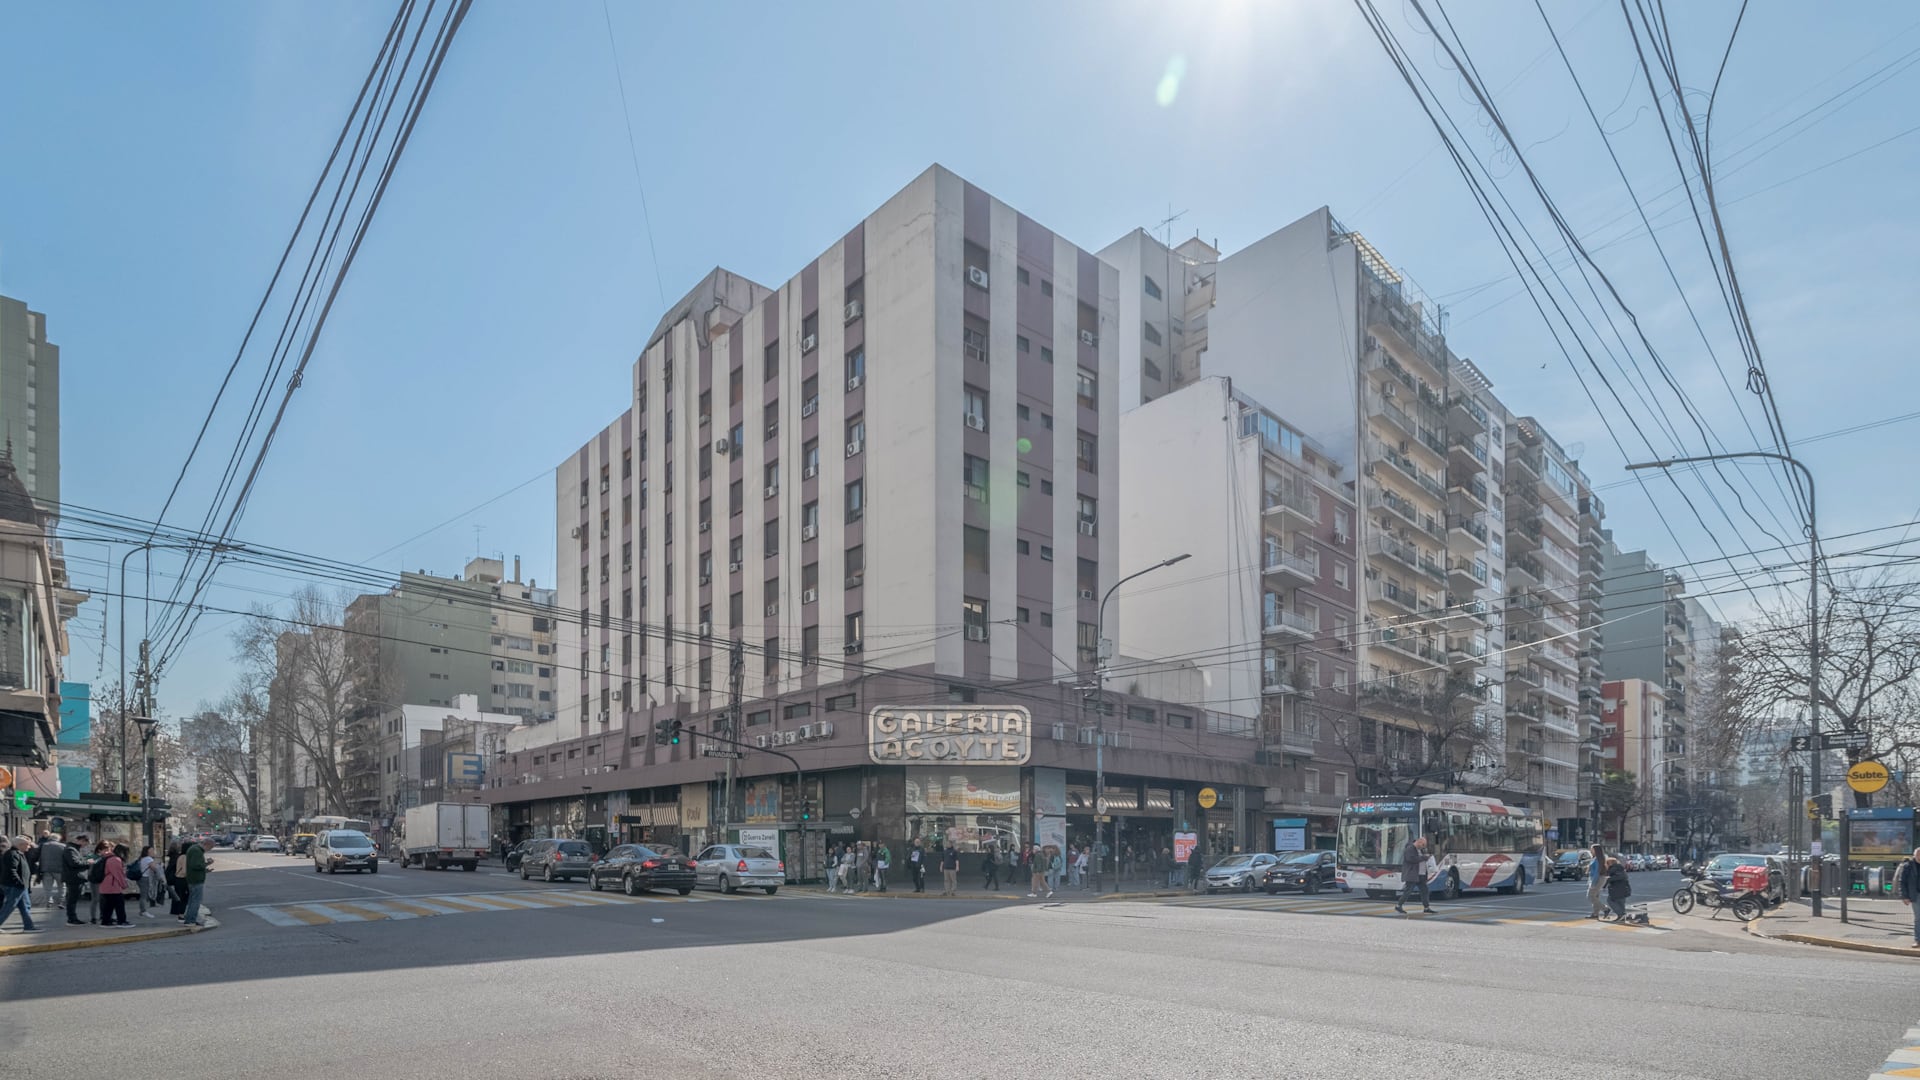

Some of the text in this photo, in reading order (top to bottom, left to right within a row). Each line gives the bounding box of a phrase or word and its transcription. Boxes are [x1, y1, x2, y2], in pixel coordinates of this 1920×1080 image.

[877, 712, 1023, 734] GALERIA
[880, 736, 1020, 758] ACOYTE
[708, 751, 738, 759] RIVADAVIA
[1852, 771, 1883, 780] Subte
[1352, 802, 1375, 813] 132
